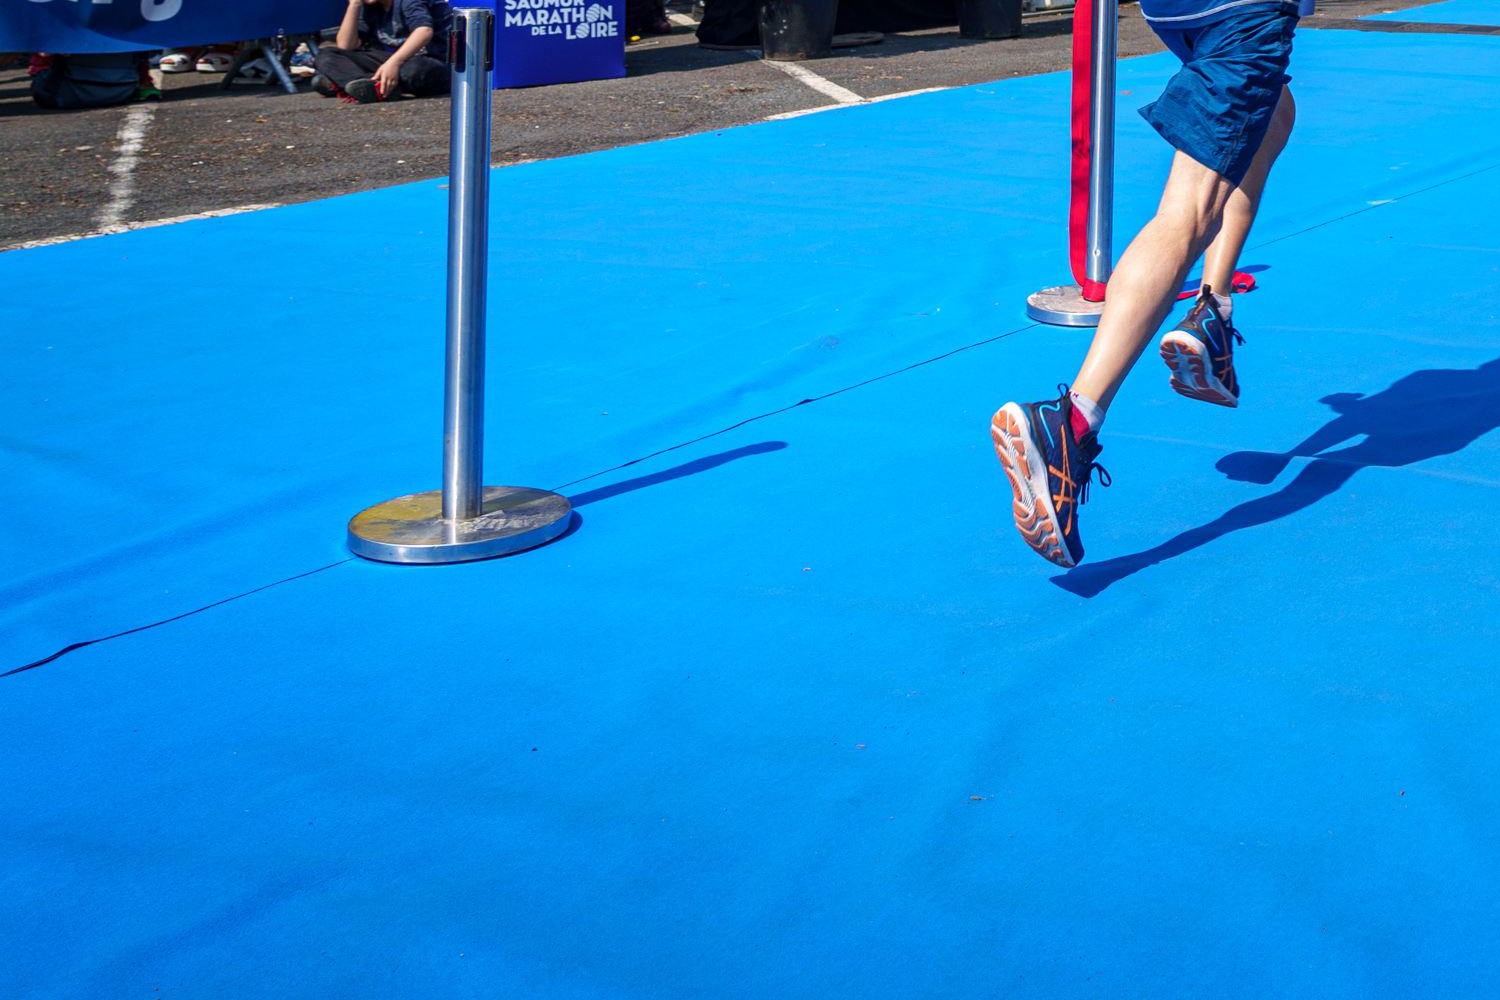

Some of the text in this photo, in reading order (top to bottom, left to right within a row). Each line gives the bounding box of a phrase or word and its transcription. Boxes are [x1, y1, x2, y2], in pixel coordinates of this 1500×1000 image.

[505, 3, 613, 27] MARATHON
[531, 21, 618, 40] DE LA LOIRE
